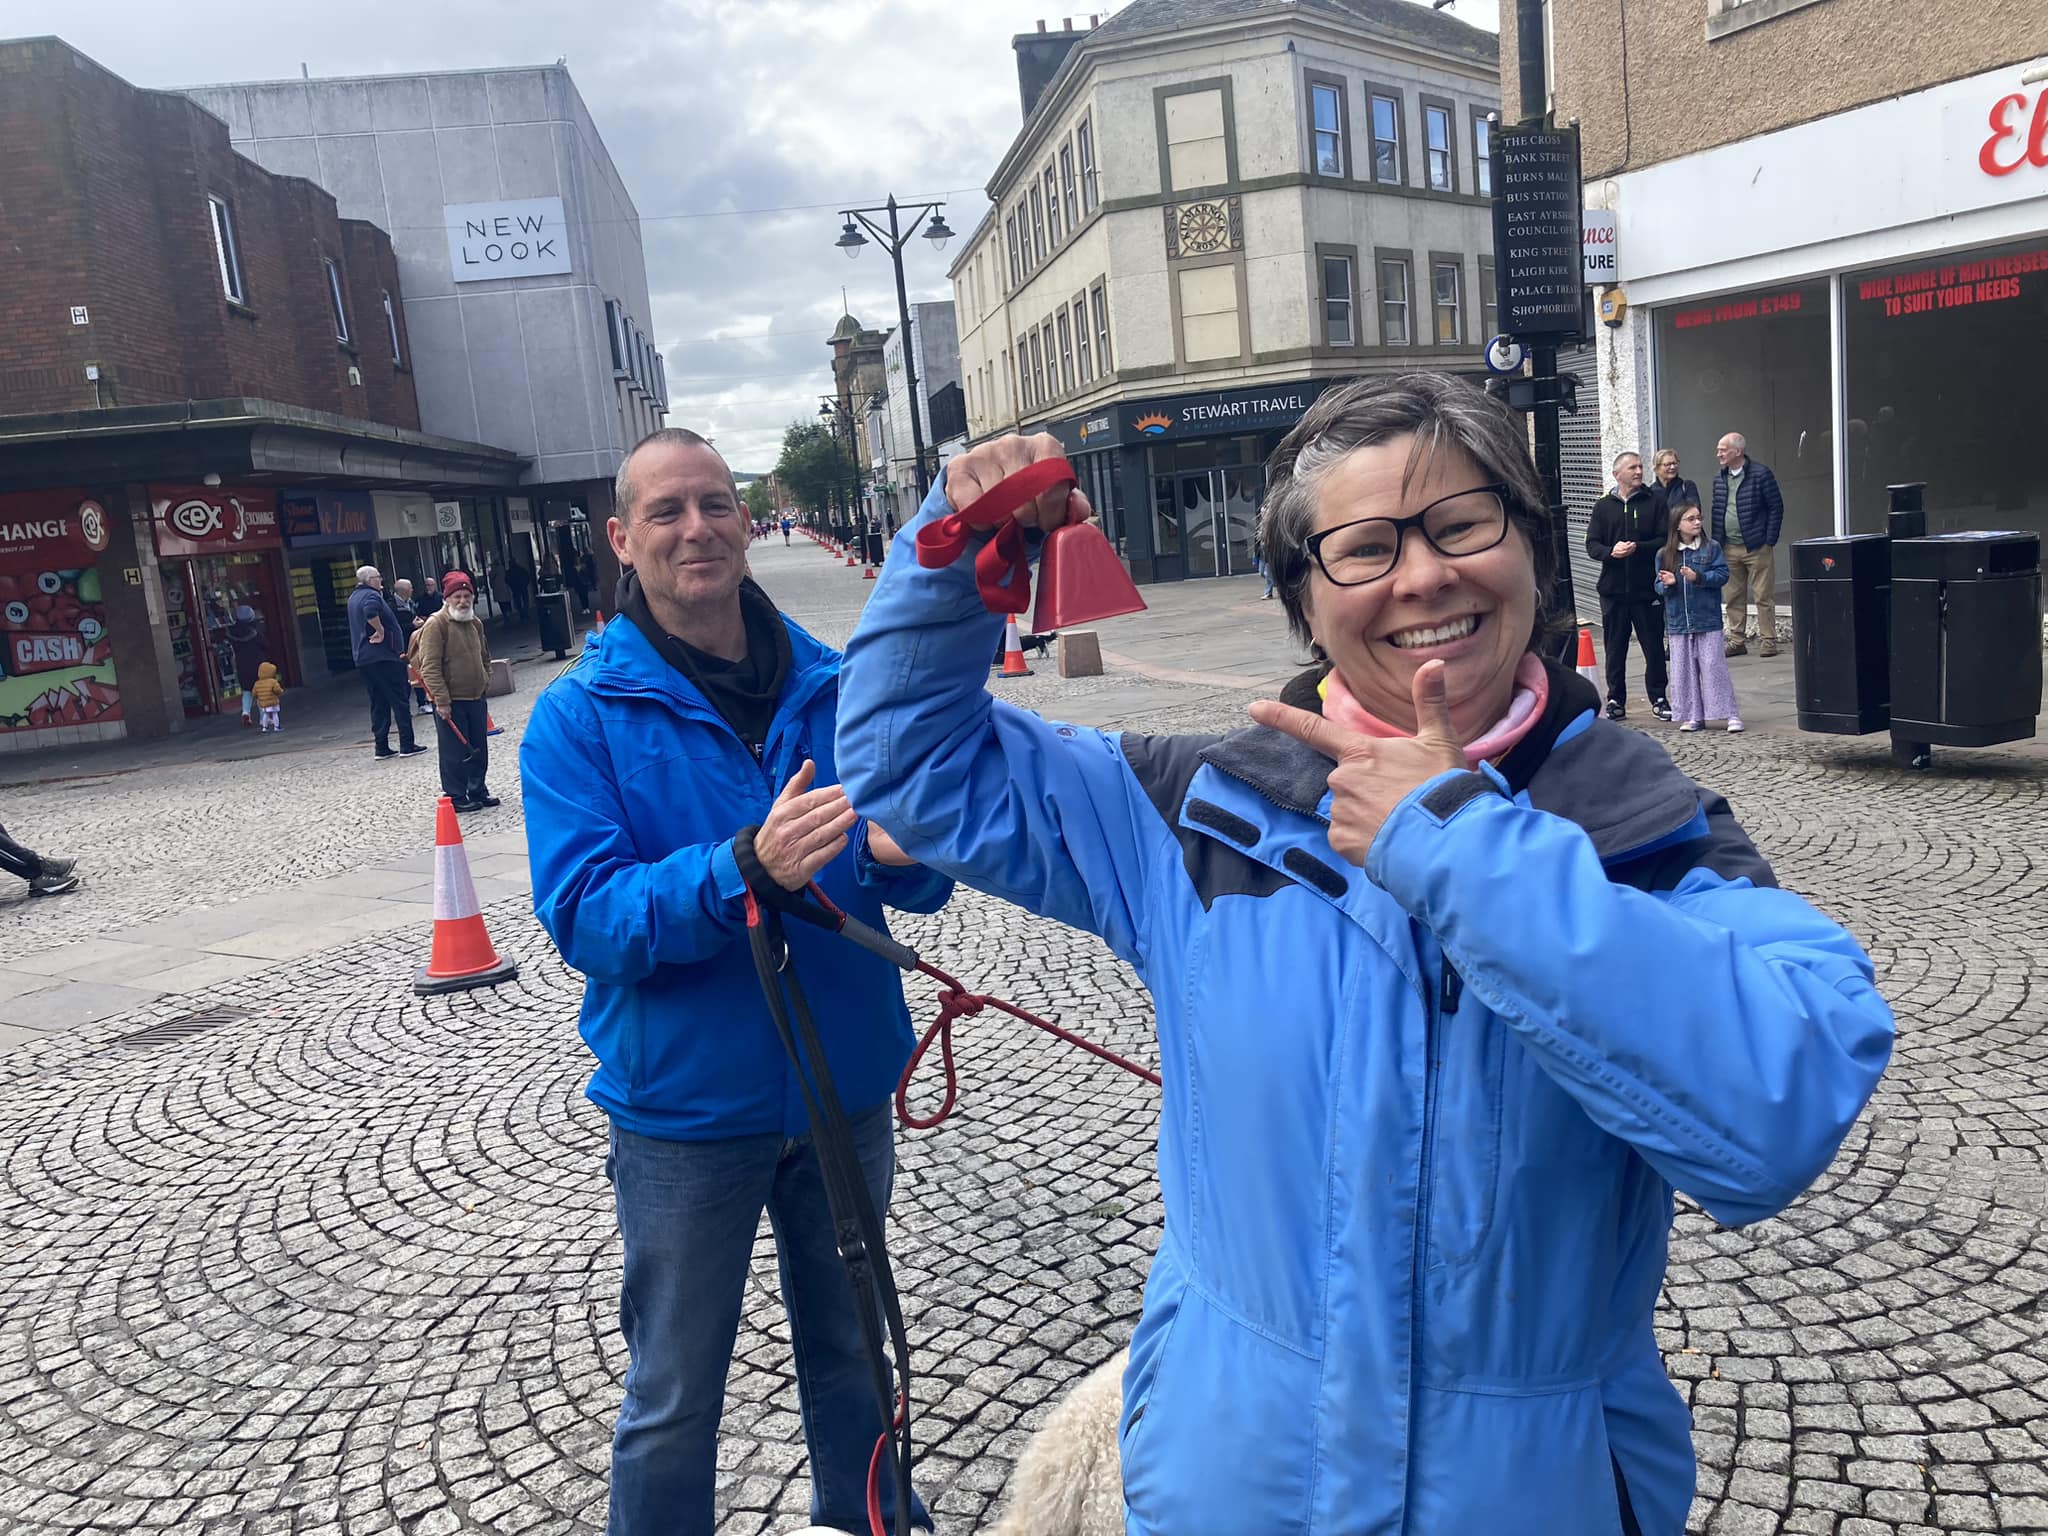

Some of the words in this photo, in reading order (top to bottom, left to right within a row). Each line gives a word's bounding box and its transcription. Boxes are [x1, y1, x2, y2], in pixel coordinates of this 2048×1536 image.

[1504, 136, 1527, 147] THE
[1530, 135, 1561, 145] CROSS
[1505, 153, 1536, 164] BANK
[1506, 172, 1544, 183] BURNS
[1547, 171, 1568, 182] MALL
[1507, 193, 1529, 202] BUS
[1533, 191, 1569, 201] STATION
[1508, 211, 1536, 222] EAST
[1540, 209, 1575, 220] AYRSH
[466, 214, 543, 239] NEW
[1180, 204, 1226, 240] KILMARNOCK
[1508, 226, 1557, 237] COUNCIL
[1190, 238, 1218, 250] CROSS
[462, 239, 556, 264] LOOK
[1510, 248, 1538, 258] KING
[1542, 247, 1573, 256] STREET
[1511, 267, 1545, 278] LAIGH
[1549, 266, 1569, 275] KIRK
[1859, 277, 1892, 300] WIDE
[1895, 269, 1937, 293] RANGE
[1940, 267, 1956, 287] OF
[1959, 250, 2048, 284] MATTRESSES
[1511, 285, 1553, 296] PALACE
[1557, 284, 1579, 294] THEAT
[1885, 297, 1901, 317] TO
[1904, 291, 1934, 314] SUIT
[1937, 286, 1973, 308] YOUR
[1976, 277, 2020, 302] NEEDS
[1182, 401, 1248, 421] STEWART
[1251, 395, 1306, 413] TRAVEL
[17, 637, 79, 663] CASH
